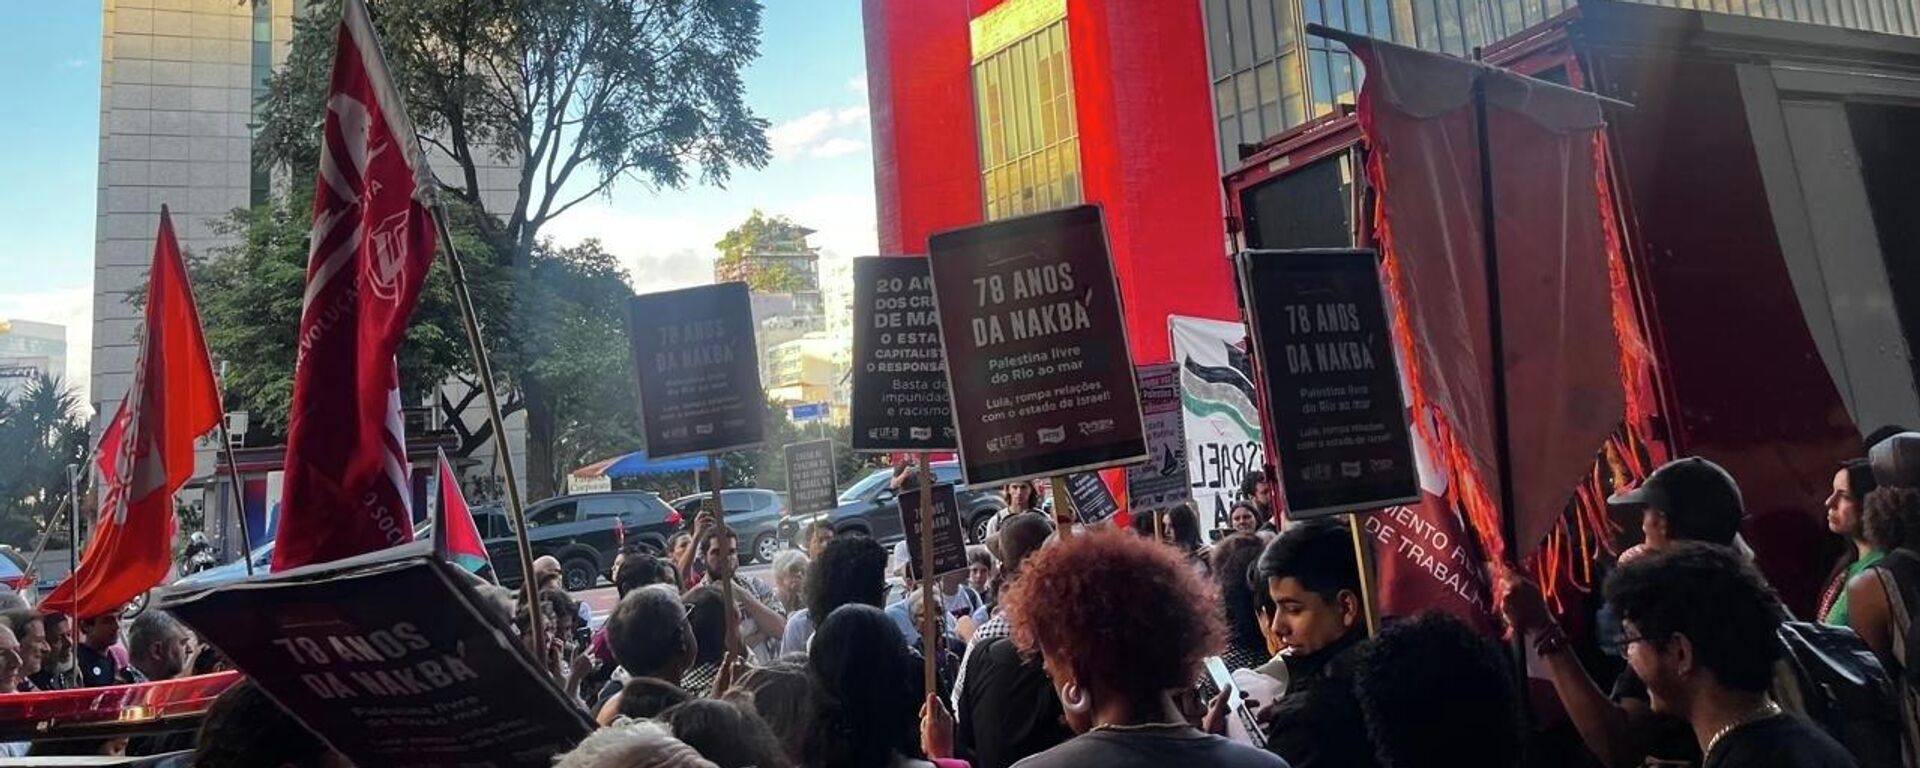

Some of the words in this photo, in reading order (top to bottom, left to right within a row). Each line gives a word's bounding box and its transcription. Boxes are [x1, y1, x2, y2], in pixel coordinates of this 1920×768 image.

[876, 277, 903, 293] 20
[973, 274, 1005, 307] 78
[1013, 262, 1075, 299] ANOS
[876, 297, 907, 310] DOS
[875, 313, 902, 328] DE
[1285, 304, 1312, 334] 78
[1316, 303, 1360, 332] ANOS
[880, 333, 892, 344] O
[972, 315, 1005, 348] DA
[866, 362, 876, 372] O
[989, 350, 1048, 371] Palestina
[1052, 345, 1081, 360] livre
[1285, 344, 1313, 375] DA
[893, 379, 928, 390] Basta
[991, 373, 1009, 385] do
[1012, 367, 1034, 382] Rio
[1038, 365, 1054, 377] ao
[1058, 360, 1084, 373] mar
[1015, 387, 1052, 404] rompa
[887, 407, 895, 416] e
[899, 405, 949, 416] racismo
[982, 411, 1006, 423] com
[1008, 409, 1016, 418] o
[1019, 402, 1057, 417] estado
[1059, 398, 1074, 409] de
[1365, 516, 1396, 545] DE
[1398, 535, 1486, 613] TRABALH
[273, 637, 330, 665] 78
[328, 622, 431, 662] ANOS
[301, 672, 358, 699] DA
